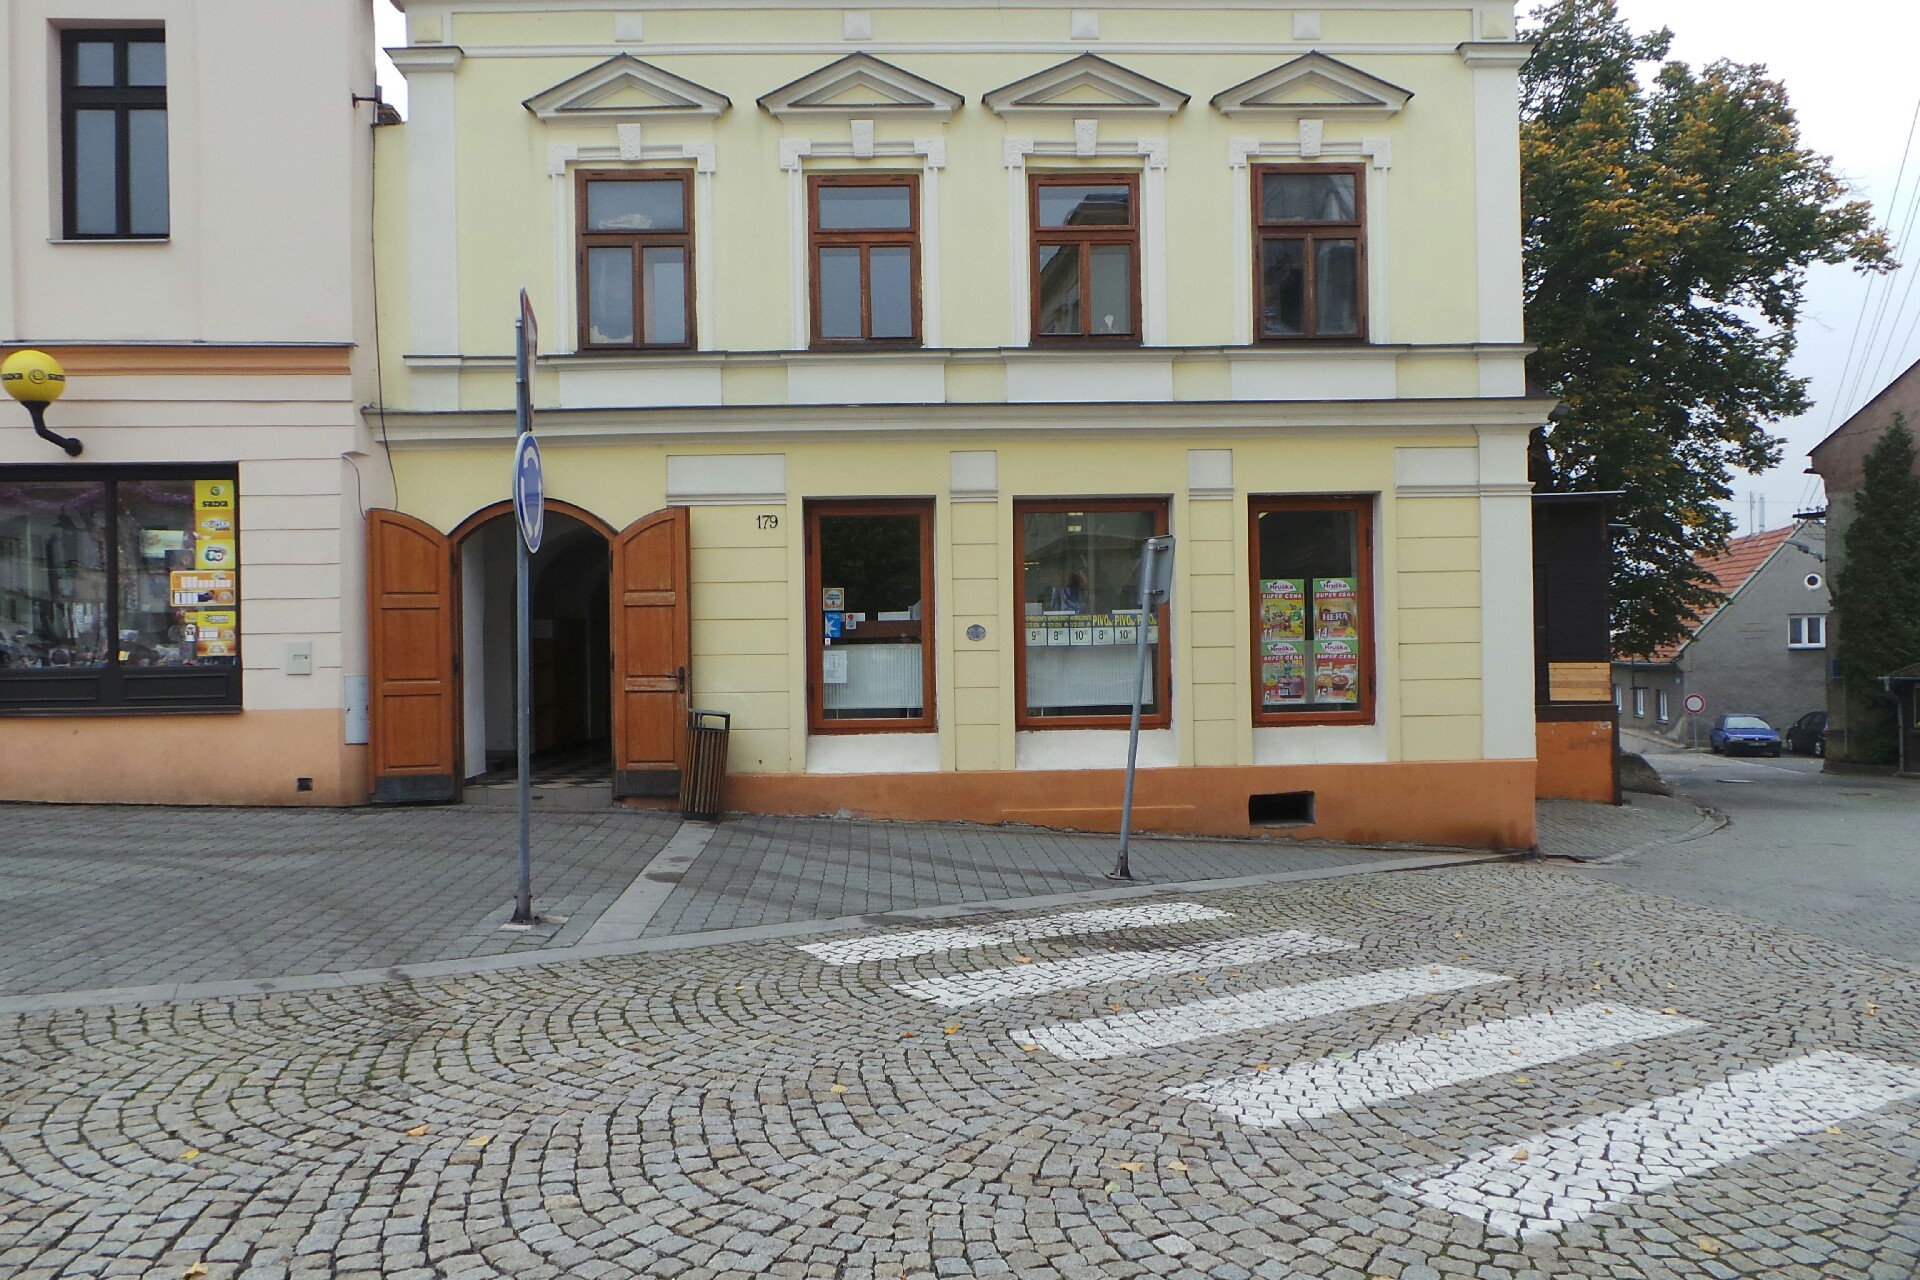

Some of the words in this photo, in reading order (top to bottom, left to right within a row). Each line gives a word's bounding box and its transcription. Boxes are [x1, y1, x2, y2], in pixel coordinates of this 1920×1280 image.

[756, 514, 778, 529] 179
[1092, 614, 1109, 626] PIVO
[1114, 614, 1131, 626] PIVO
[1322, 612, 1348, 621] HERA
[1053, 630, 1059, 640] 8
[1075, 630, 1084, 640] 10
[1098, 629, 1104, 640] 8
[1119, 629, 1129, 640] 10
[1317, 627, 1329, 640] 14
